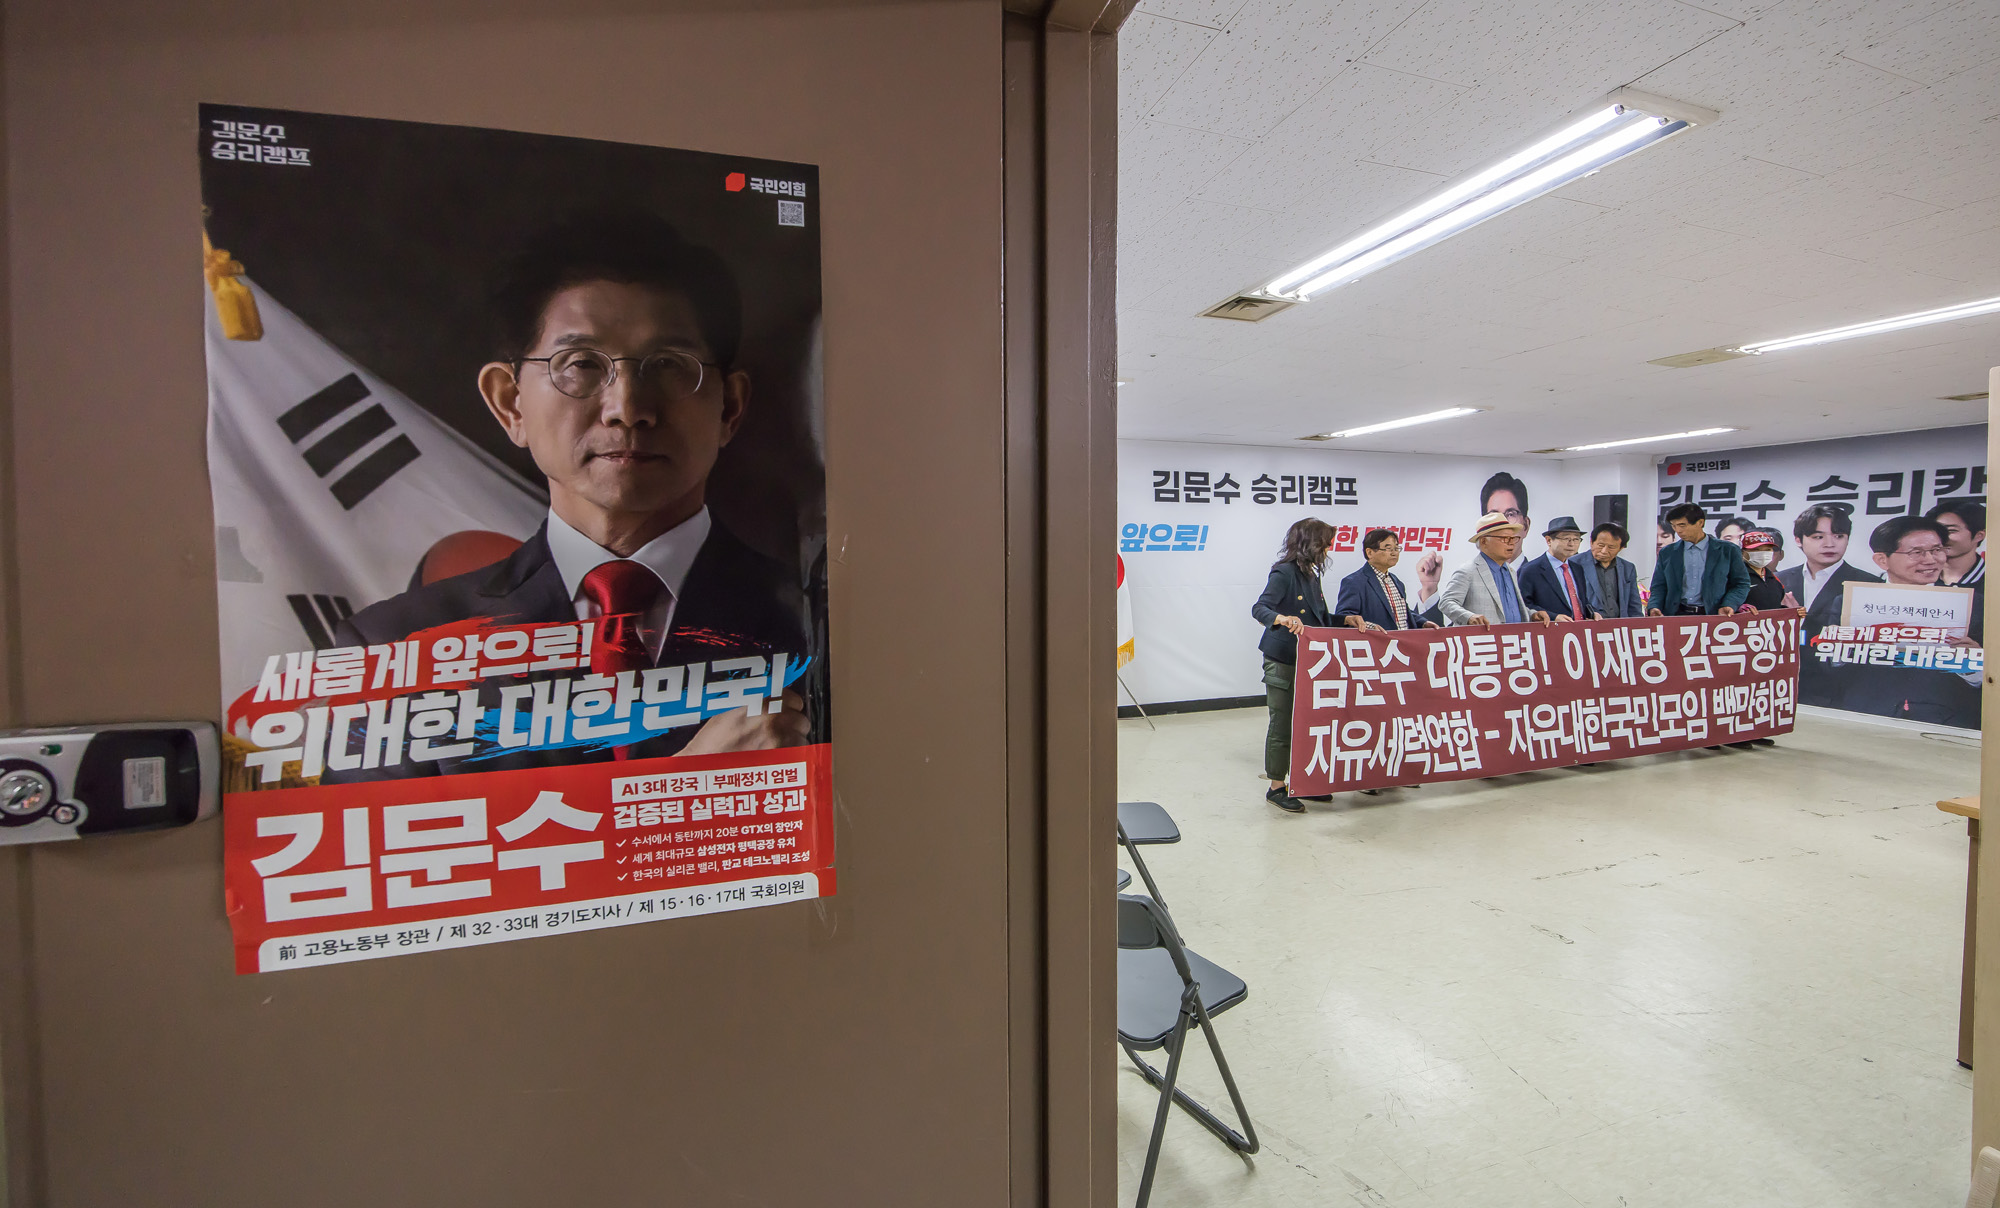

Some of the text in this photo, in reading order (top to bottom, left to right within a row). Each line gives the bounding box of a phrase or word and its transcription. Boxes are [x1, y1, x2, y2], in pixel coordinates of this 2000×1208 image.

[211, 120, 286, 143] 김문수
[211, 140, 311, 167] 승리캠프
[750, 177, 806, 197] 국민의힘
[1686, 460, 1730, 472] 국민의힘
[1153, 470, 1359, 506] 김문수 승리캠프
[1120, 523, 1209, 552] 앞으로!
[1863, 603, 1954, 619] 청년정책제안서
[1818, 626, 1947, 643] 새롭게 앞으로!
[250, 623, 594, 704] 새롭게 앞으로!
[1307, 618, 1796, 709] 김문수 대통령! 이재명 감옥행!!
[1814, 642, 1899, 666] 위대한
[244, 689, 485, 784] 위대한
[498, 652, 789, 749] 대한민국!
[1304, 710, 1485, 783] 자유세력연합
[1503, 688, 1708, 761] 자유대한국민모임
[1712, 677, 1794, 735] 백만회원
[622, 767, 798, 796] AI 3대 강국 부패정치 엄벌
[613, 789, 807, 829] 검증된 실력과 성과
[632, 834, 672, 848] 수서에서
[675, 828, 713, 843] 동탄까지
[716, 825, 738, 838] 20분
[741, 822, 773, 836] GTX의
[251, 790, 605, 923] 김문수
[632, 837, 796, 864] 세계 최대규모 삼성전자 평택공장 유치
[633, 867, 663, 881] 한국의
[666, 863, 695, 878] 실리콘
[722, 858, 742, 871] 판교
[743, 853, 790, 867] 테크노밸리
[792, 850, 810, 863] 조성
[279, 945, 297, 961] 前
[304, 933, 391, 958] 고용노동부
[397, 928, 430, 946] 장관
[450, 923, 467, 940] 제
[545, 904, 621, 928] 경기도지사
[639, 896, 654, 914] 제
[751, 879, 805, 899] 국회의원
